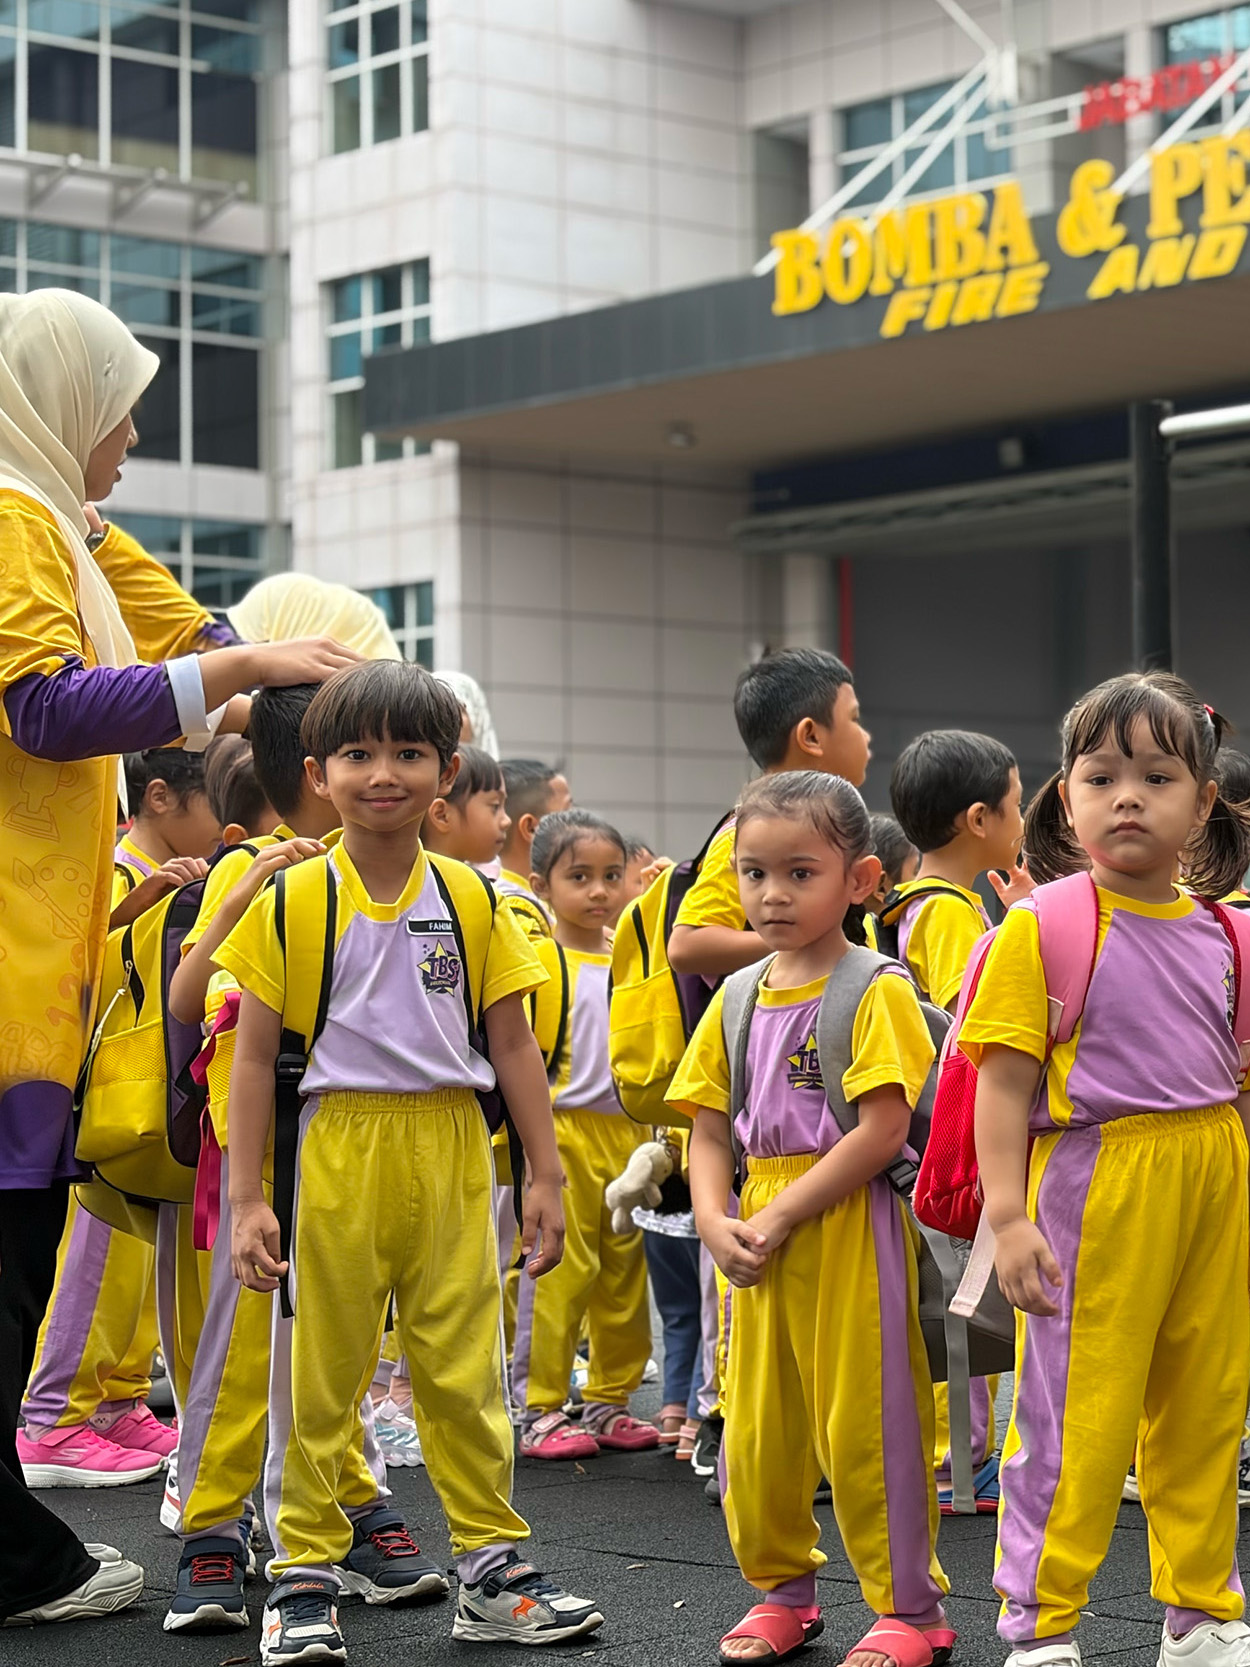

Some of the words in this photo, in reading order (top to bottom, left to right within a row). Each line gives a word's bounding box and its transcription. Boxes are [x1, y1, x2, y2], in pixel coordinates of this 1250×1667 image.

[770, 182, 1041, 316] BOMBA
[1057, 159, 1128, 258] &
[880, 261, 1051, 338] FIRE
[1087, 225, 1248, 301] AND
[428, 955, 461, 981] TBS
[795, 1049, 821, 1074] TB
